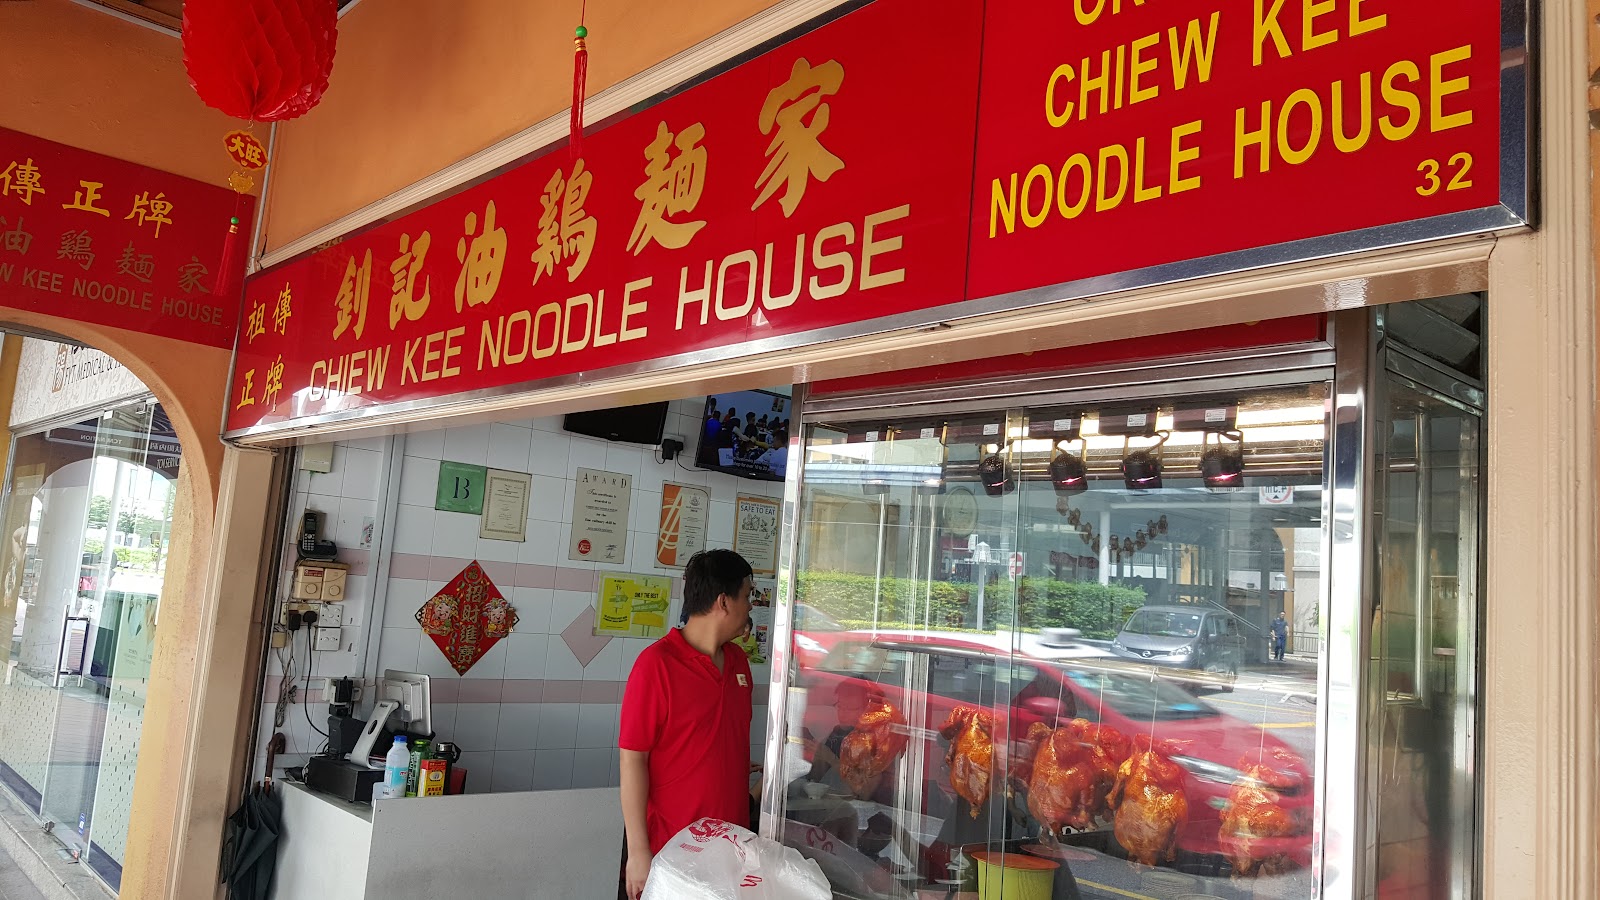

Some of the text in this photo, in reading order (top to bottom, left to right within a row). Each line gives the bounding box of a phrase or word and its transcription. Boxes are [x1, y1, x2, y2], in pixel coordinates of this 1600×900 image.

[1045, 0, 1387, 128] CHIEW KEE
[989, 44, 1473, 239] NOODLE HOUSE
[1415, 152, 1473, 196] 32
[22, 267, 64, 293] KEE
[72, 277, 153, 311] NOODLE
[162, 297, 223, 325] HOUSE
[309, 204, 910, 402] CHIEW KEE NOODLE HOUSE
[453, 476, 470, 499] B
[582, 473, 627, 489] AWARD
[765, 508, 776, 516] EAT
